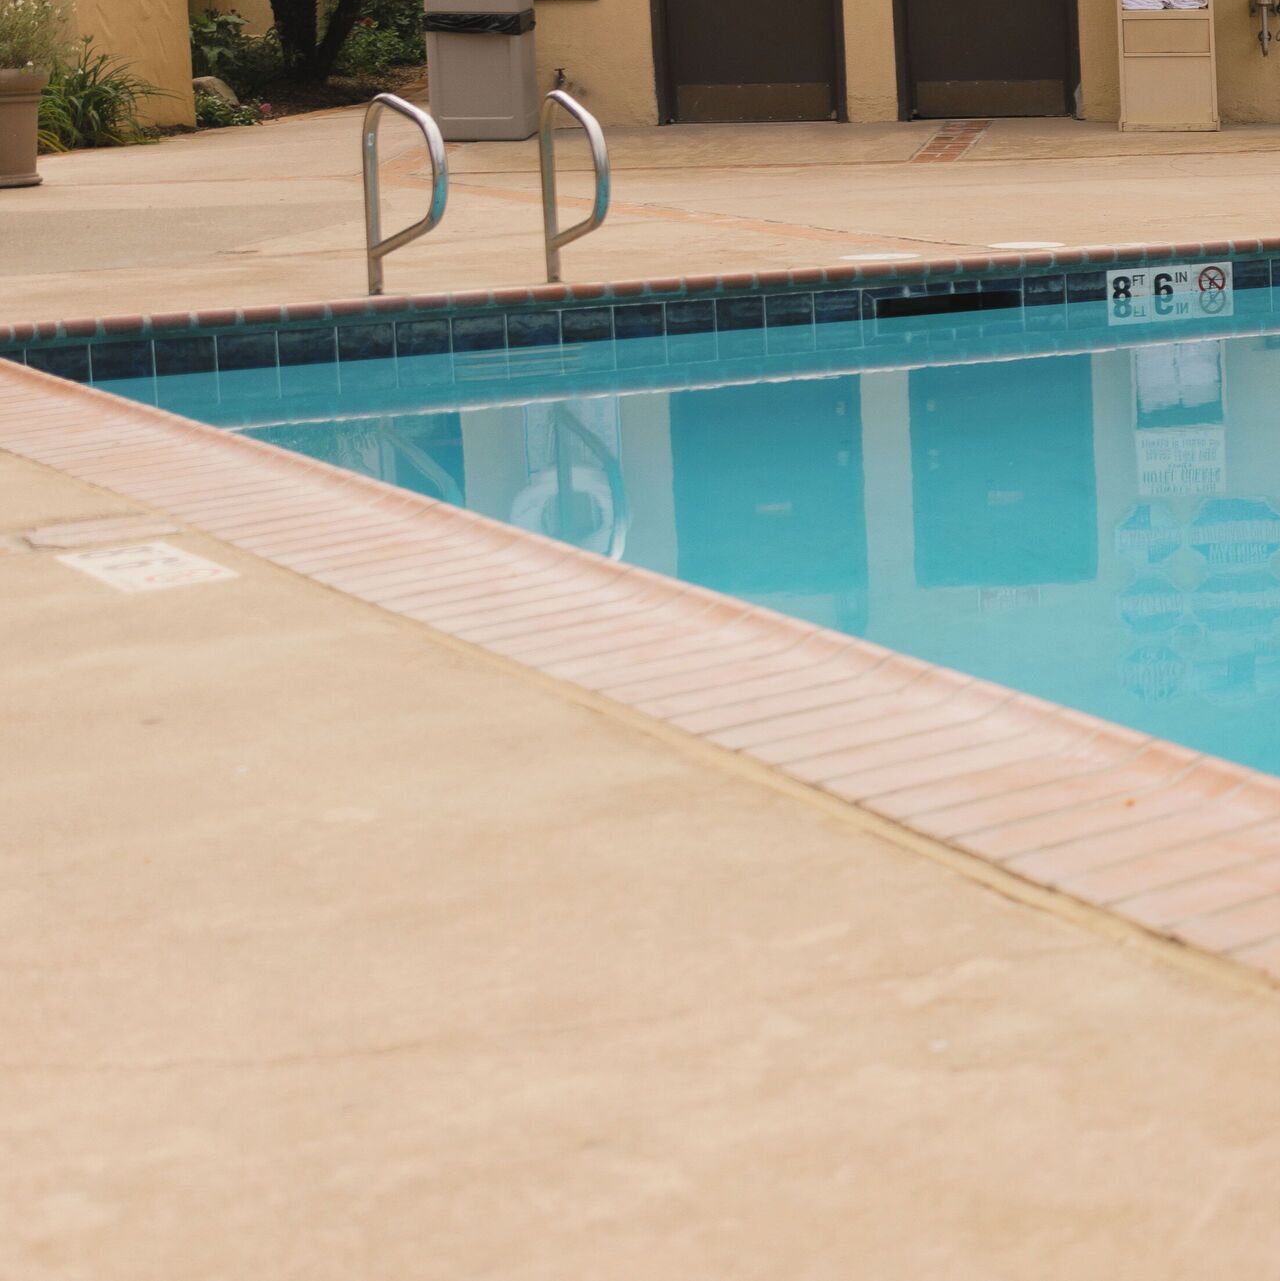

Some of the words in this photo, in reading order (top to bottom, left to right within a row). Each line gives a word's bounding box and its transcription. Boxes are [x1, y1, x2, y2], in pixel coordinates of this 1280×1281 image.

[1112, 276, 1132, 299] 8
[1132, 274, 1146, 286] FT
[1154, 272, 1174, 296] 6
[1175, 271, 1188, 283] IN
